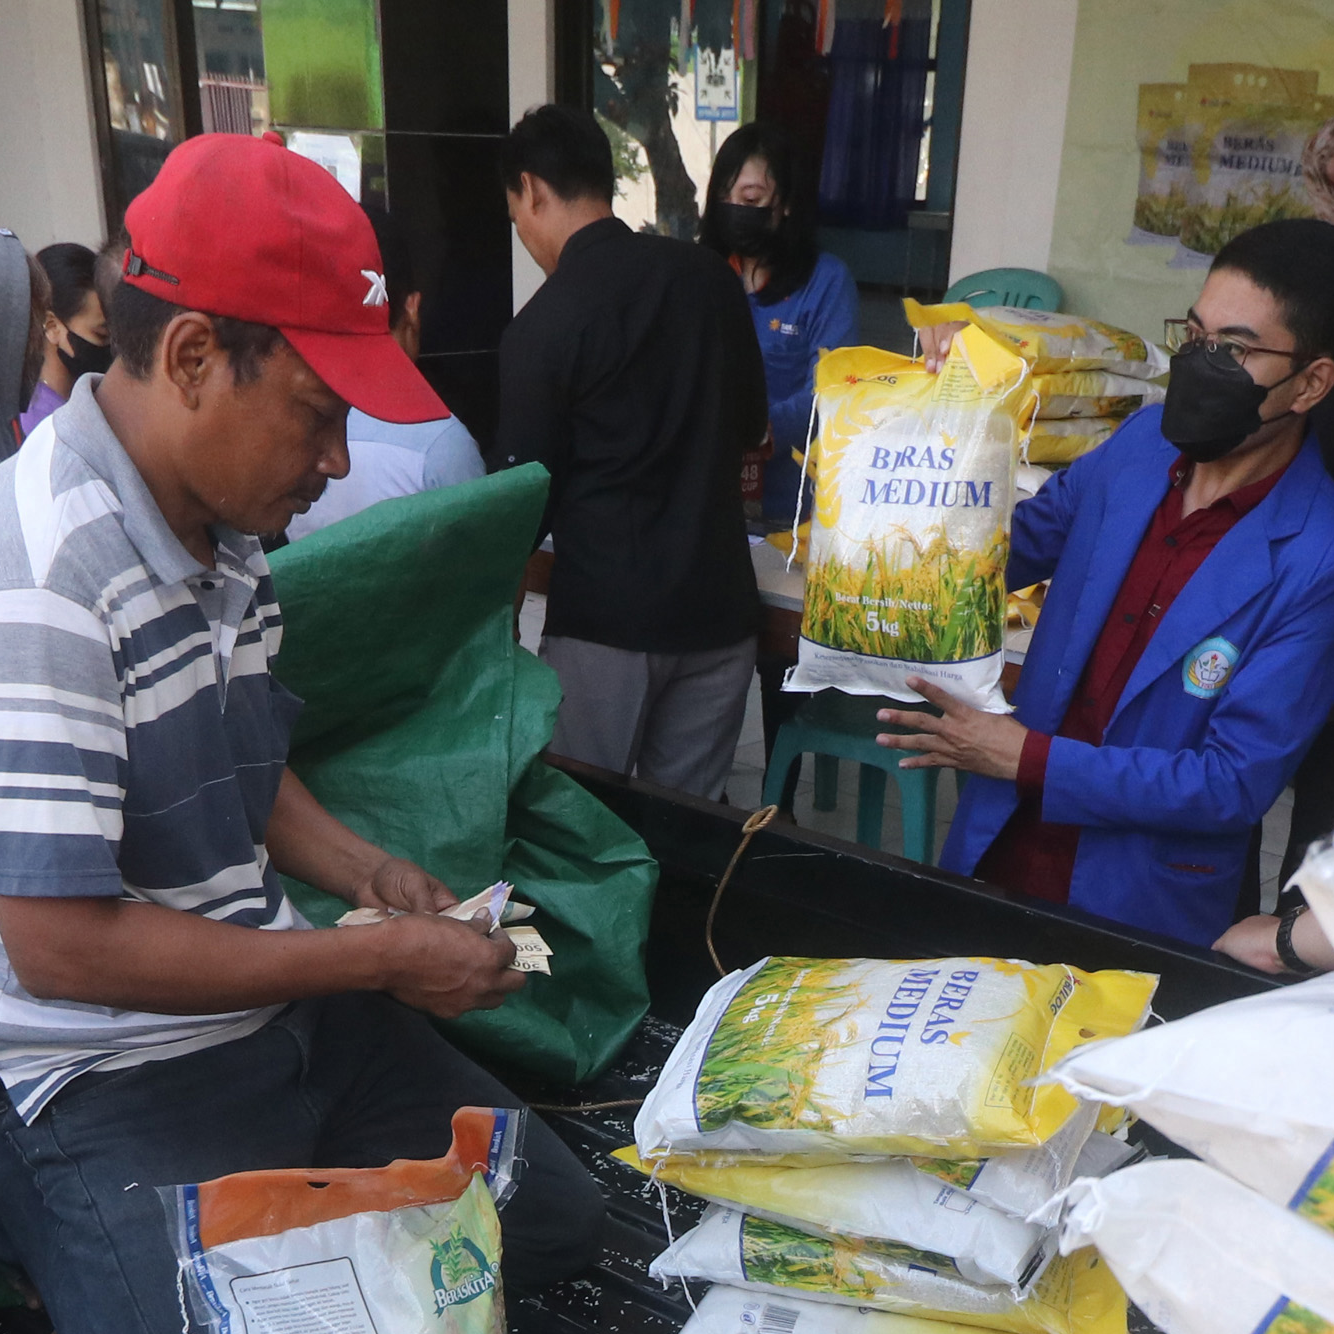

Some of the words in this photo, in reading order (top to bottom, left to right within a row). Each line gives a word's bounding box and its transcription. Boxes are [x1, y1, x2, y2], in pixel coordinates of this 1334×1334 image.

[859, 478, 994, 508] MEDIUM
[866, 611, 879, 632] 5
[880, 621, 900, 638] kg
[754, 993, 780, 1009] 5
[920, 970, 979, 1046] BERAS
[741, 1008, 765, 1026] kg
[864, 967, 942, 1102] MEDIUM
